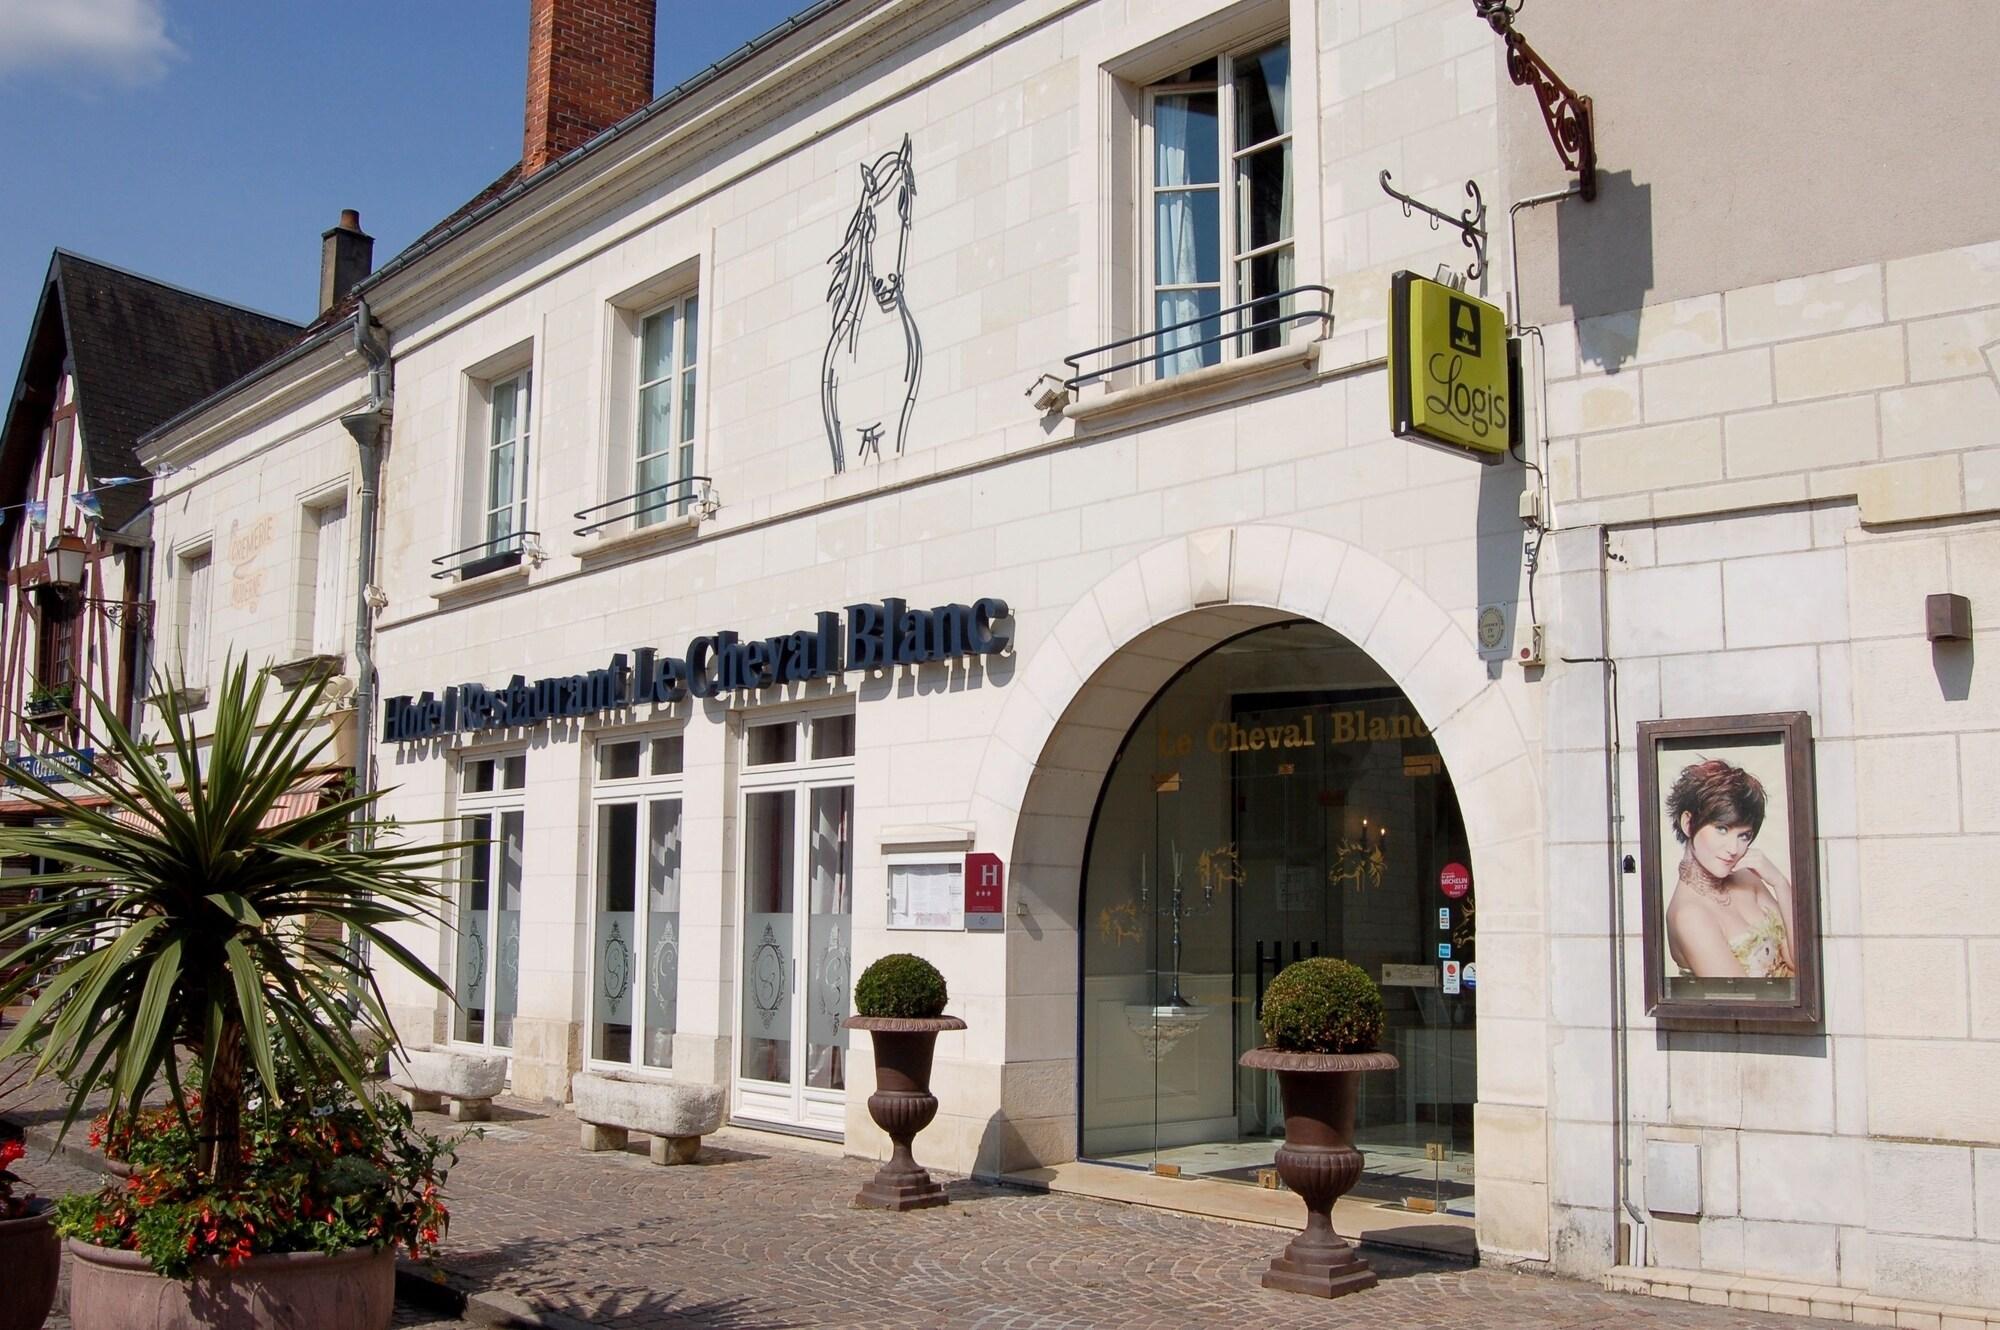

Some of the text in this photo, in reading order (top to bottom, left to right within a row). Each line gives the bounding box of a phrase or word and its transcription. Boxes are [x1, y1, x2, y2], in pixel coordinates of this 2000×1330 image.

[1426, 353, 1506, 437] Logis
[381, 597, 1010, 743] Hotel Restaurant Le Cheval Blanc
[1156, 709, 1432, 757] Le Cheval Blanc
[982, 865, 998, 886] H
[1441, 877, 1467, 885] MICHELIN
